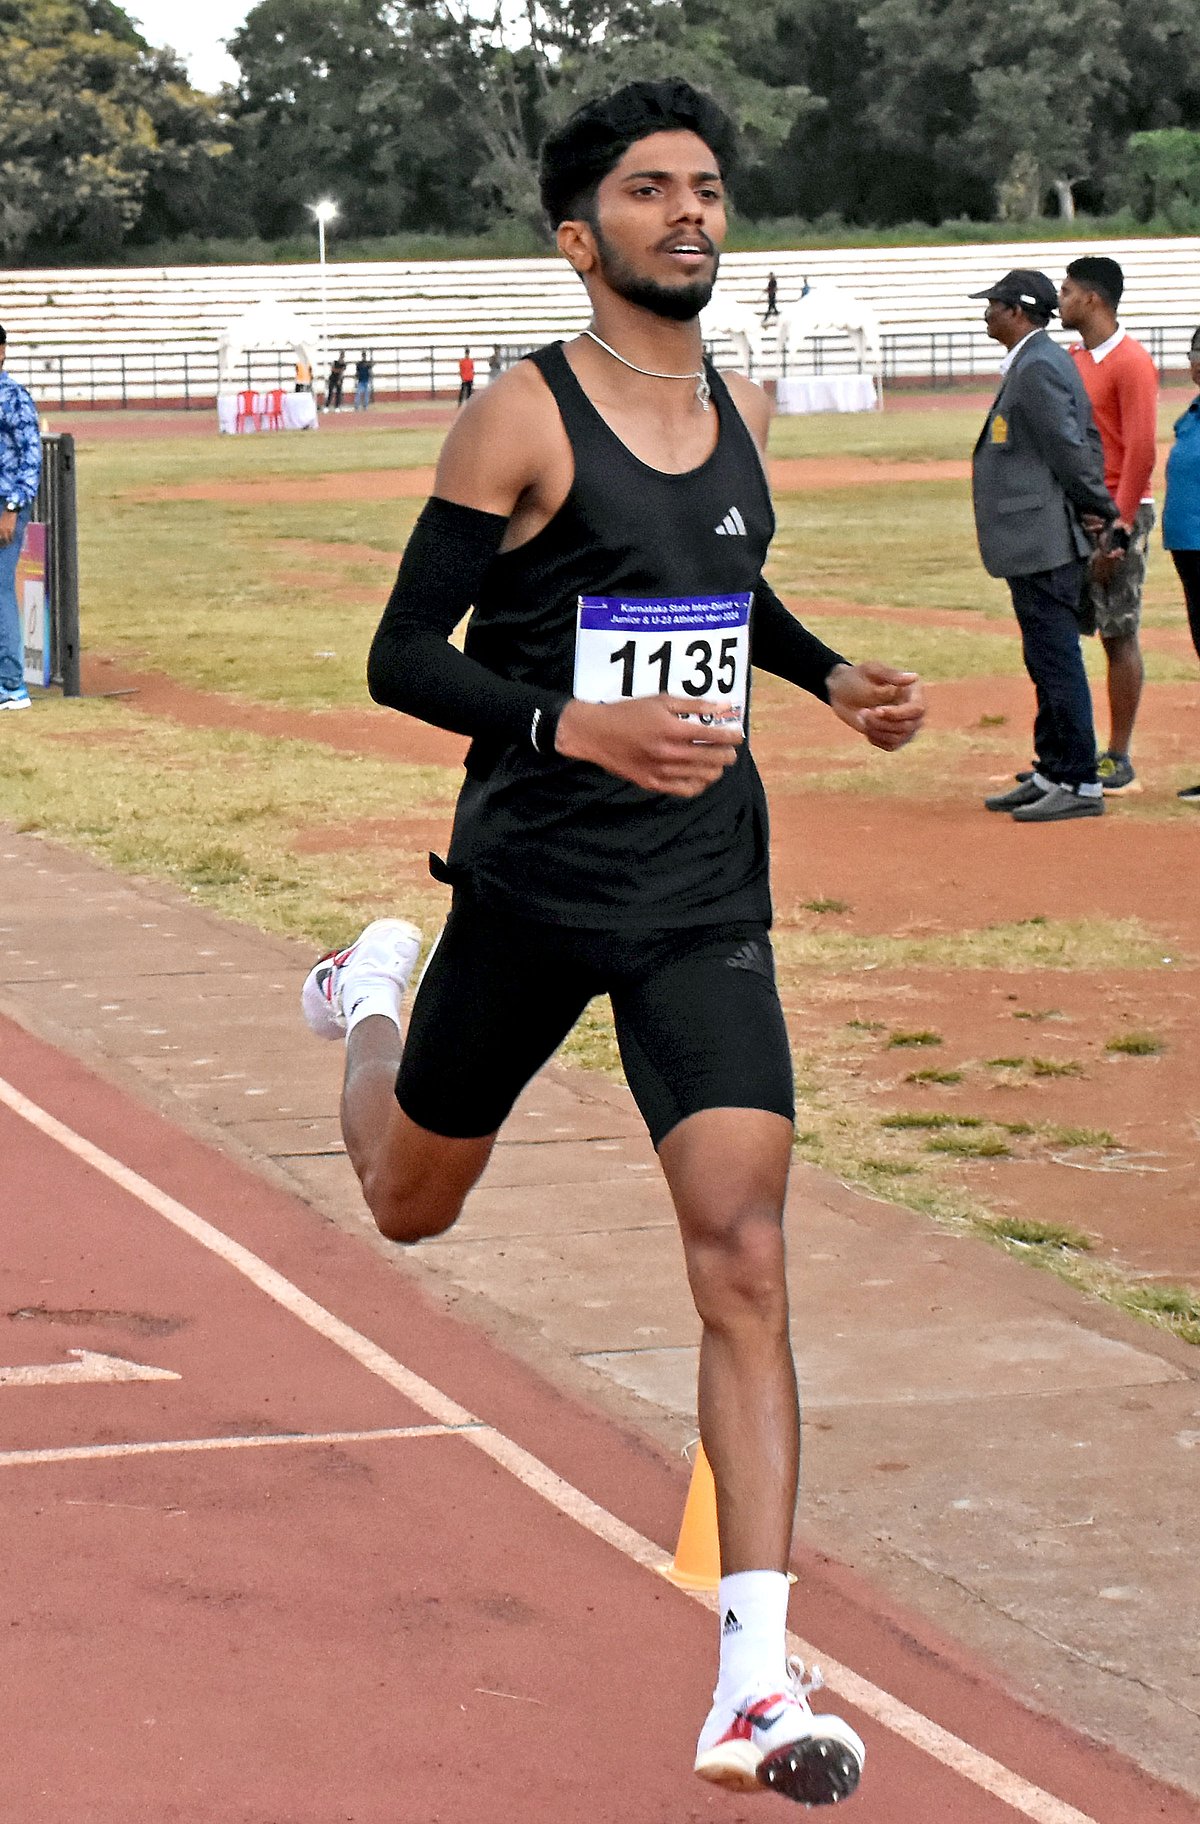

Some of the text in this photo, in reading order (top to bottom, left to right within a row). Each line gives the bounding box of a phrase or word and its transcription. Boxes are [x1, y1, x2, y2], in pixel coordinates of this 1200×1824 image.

[620, 603, 667, 613] Karnataka
[668, 603, 690, 613] State
[610, 614, 640, 624] Junior
[642, 615, 650, 625] &
[673, 613, 704, 624] Athletic
[610, 637, 739, 697] 1135
